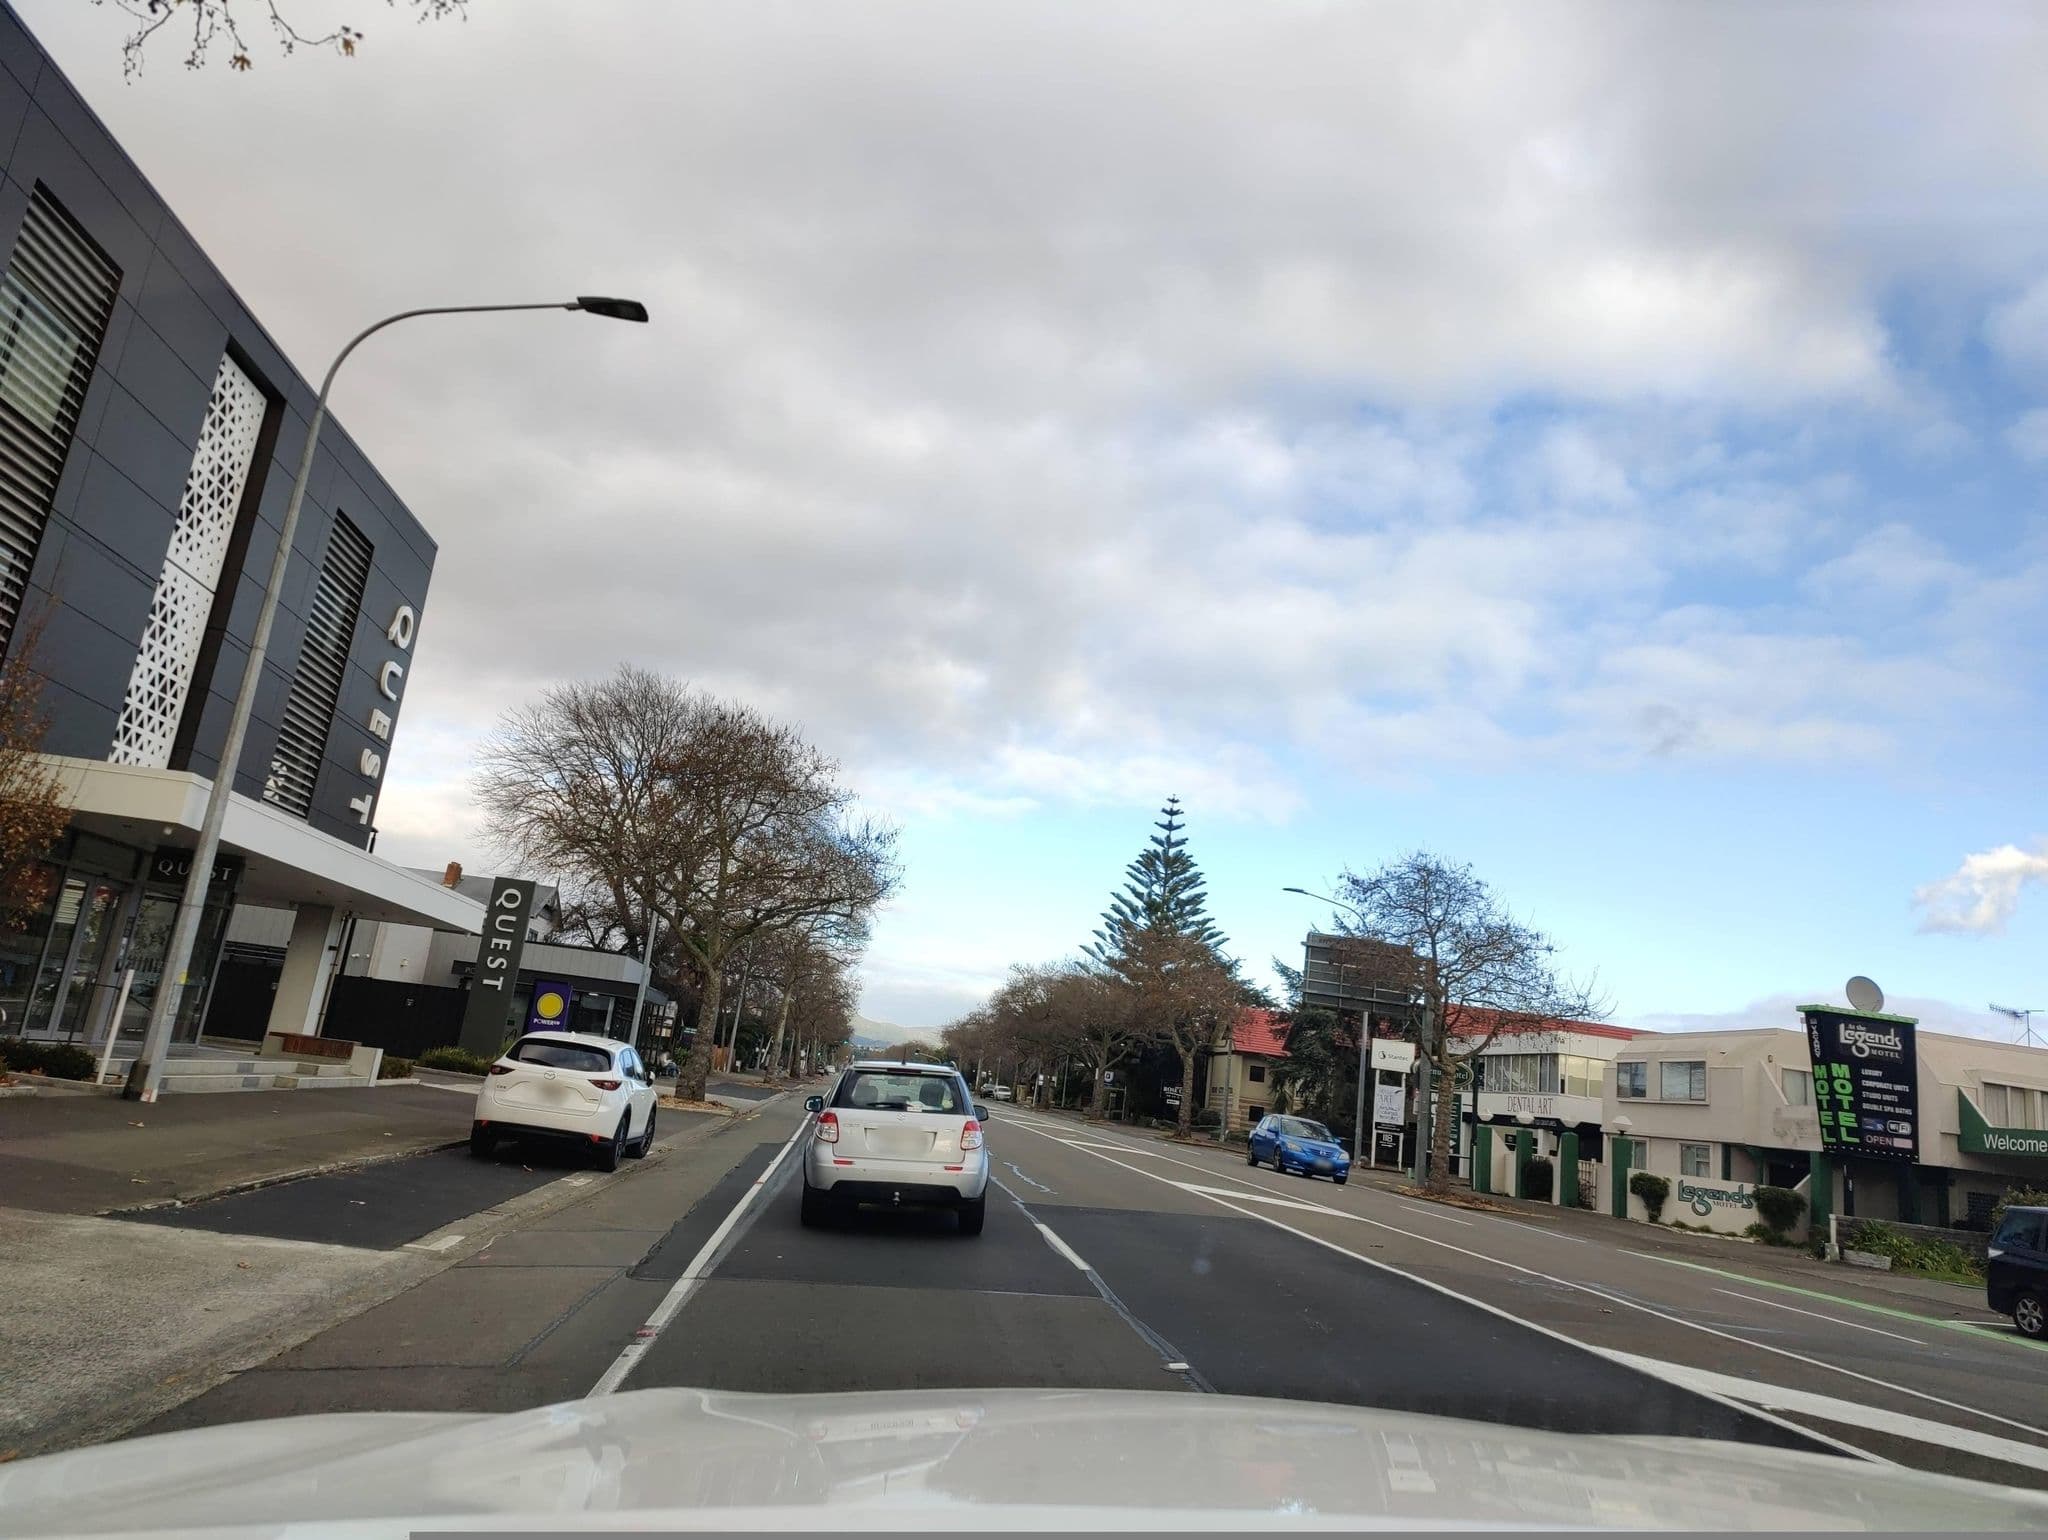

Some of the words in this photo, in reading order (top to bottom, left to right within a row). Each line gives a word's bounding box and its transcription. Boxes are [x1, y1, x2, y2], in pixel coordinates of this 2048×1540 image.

[350, 605, 414, 825] QUEST
[158, 859, 232, 880] QUST
[482, 888, 522, 991] QUEST
[1839, 1023, 1902, 1058] Legends
[1871, 1048, 1901, 1059] MOTEL
[1507, 1096, 1535, 1114] DENTAL
[1537, 1097, 1554, 1115] ART
[1814, 1064, 1837, 1143] MOTEL
[1830, 1062, 1860, 1143] MOTEL
[1865, 1134, 1893, 1146] OPEN
[1983, 1133, 2048, 1153] Welcome
[1678, 1179, 1754, 1217] Legends
